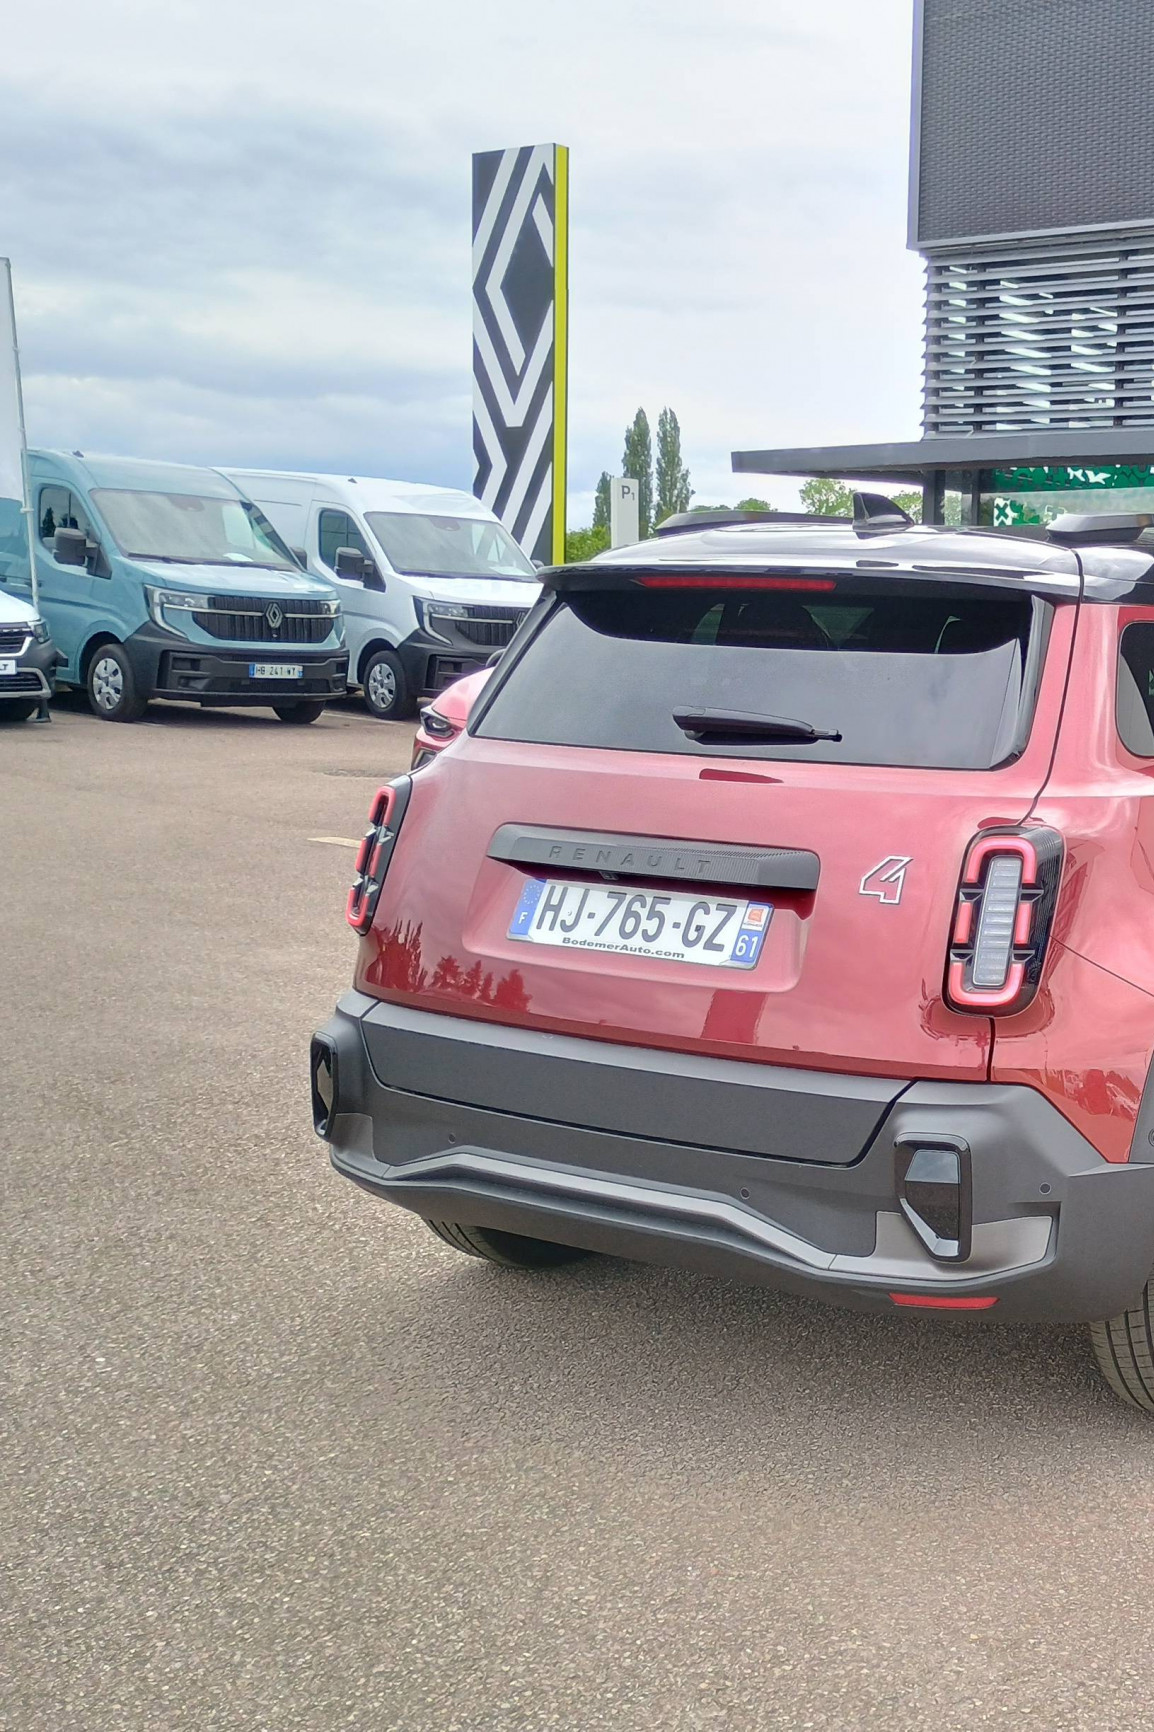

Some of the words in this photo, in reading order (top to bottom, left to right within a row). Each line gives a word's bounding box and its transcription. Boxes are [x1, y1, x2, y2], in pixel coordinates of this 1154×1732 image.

[549, 845, 711, 874] RENAULT
[518, 912, 528, 925] F
[536, 885, 738, 952] HJ-765-GZ
[562, 937, 685, 959] BodemerAuto.com
[735, 934, 759, 958] 61
